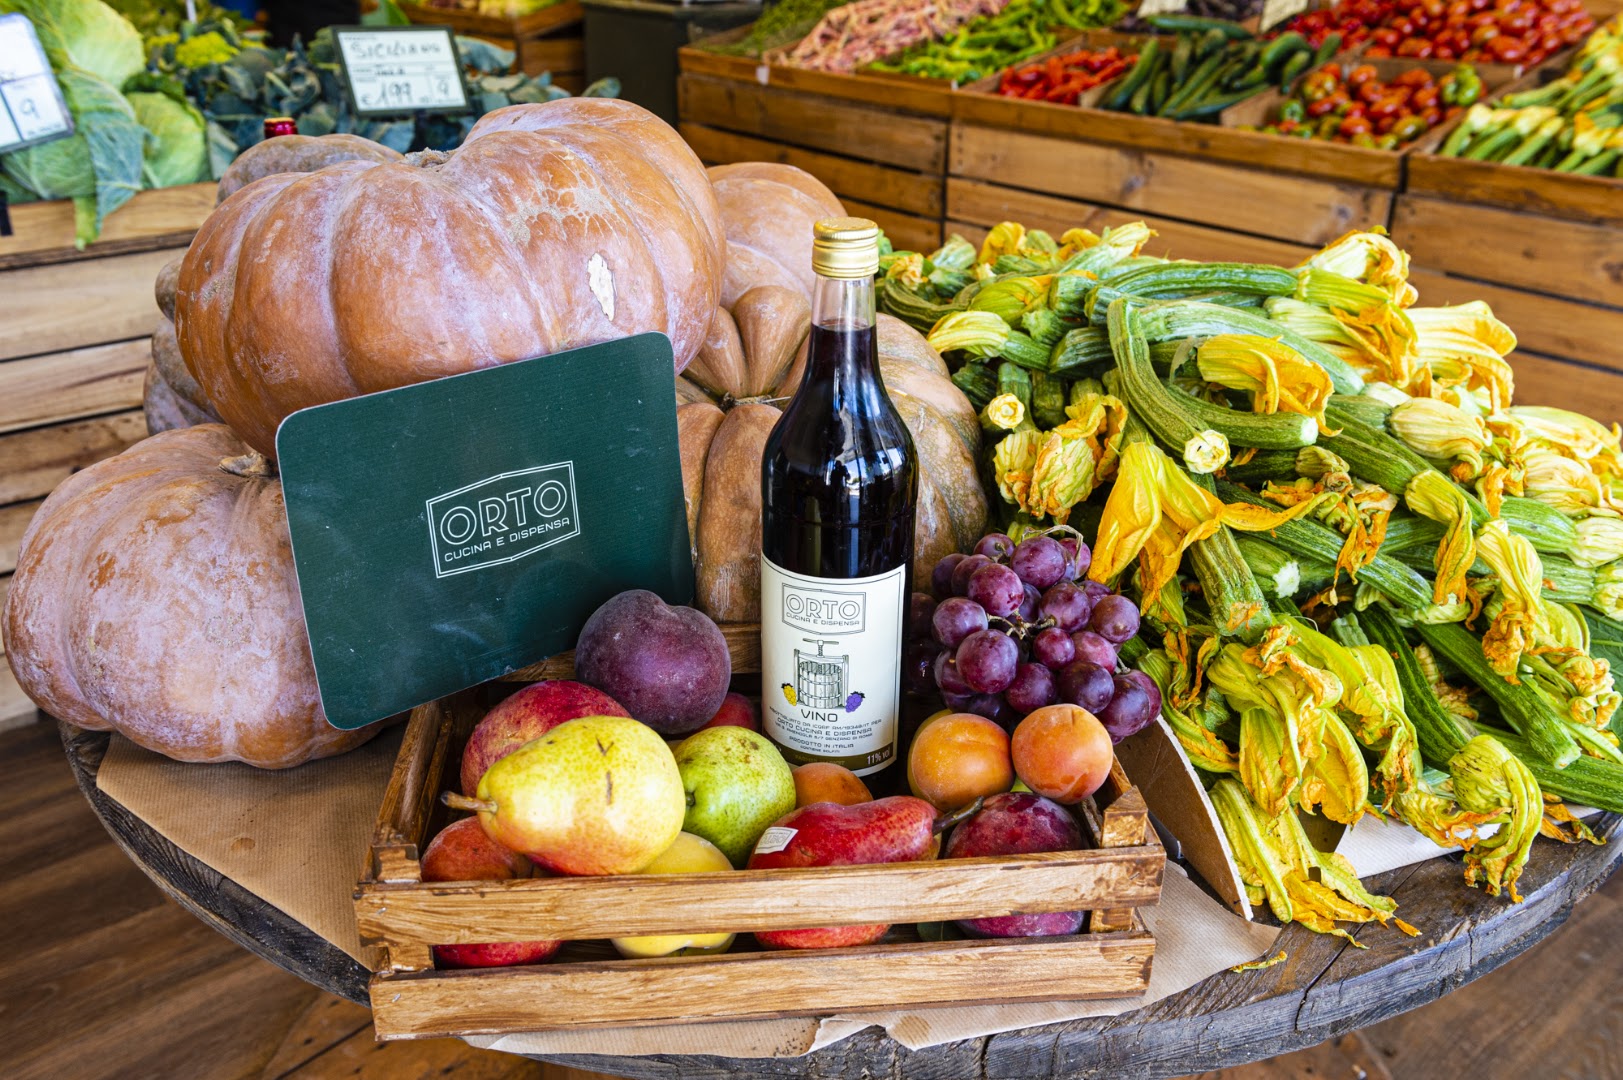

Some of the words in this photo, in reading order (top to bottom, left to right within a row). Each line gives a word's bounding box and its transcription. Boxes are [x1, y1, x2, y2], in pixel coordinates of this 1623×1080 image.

[440, 480, 568, 545] ORTO
[444, 540, 492, 562] CUCINA
[496, 536, 505, 547] E
[509, 517, 570, 543] DISPENSA
[786, 593, 860, 620] ORTO
[786, 611, 811, 623] CUCINA
[801, 709, 838, 722] VINO
[777, 716, 794, 728] ORTO
[795, 725, 823, 735] CUCINA
[833, 727, 872, 736] DISPENSA
[789, 736, 822, 748] PRODOTTO
[867, 751, 882, 765] 11%
